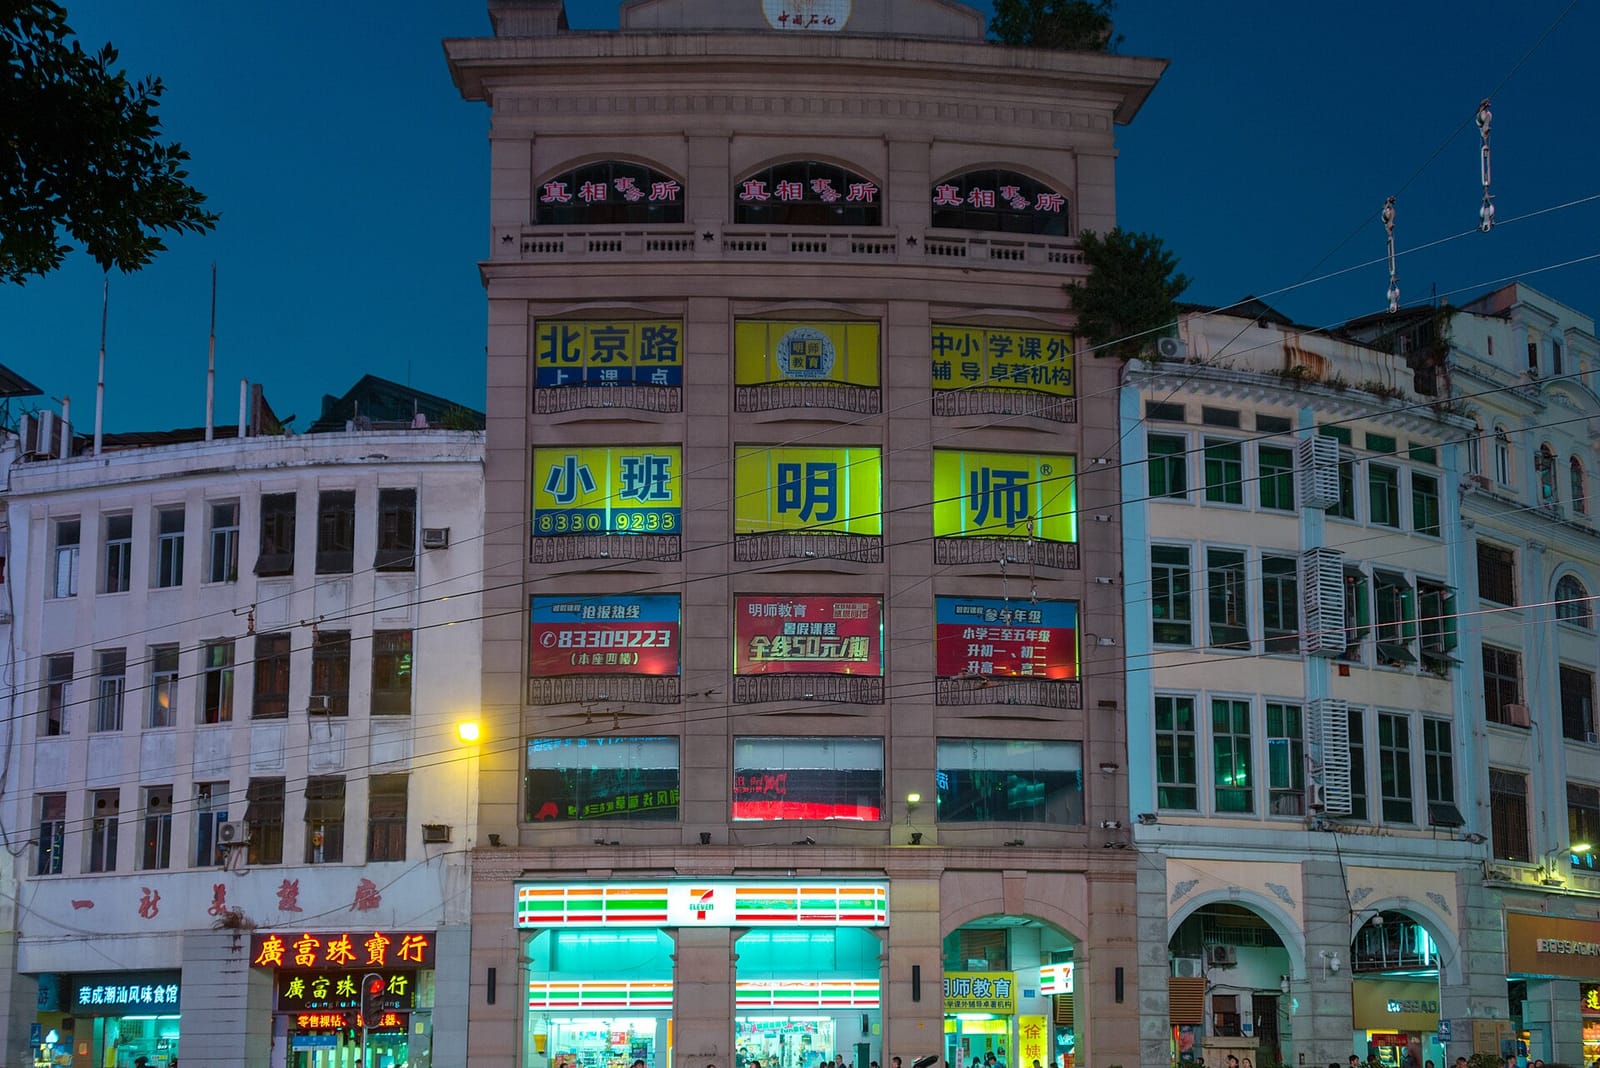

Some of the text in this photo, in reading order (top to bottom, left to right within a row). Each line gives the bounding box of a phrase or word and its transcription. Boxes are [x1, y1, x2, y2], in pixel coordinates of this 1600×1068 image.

[540, 176, 681, 203] 真相事务所
[739, 178, 878, 203] 真相事务所
[933, 184, 1066, 213] 真相事务所
[540, 325, 679, 363] 北京路
[932, 332, 1071, 363] 中小学课外
[932, 360, 1072, 387] 辅导卓著机构
[544, 454, 673, 505] 小班
[778, 462, 837, 522] 明
[970, 467, 1029, 528] 师
[539, 512, 676, 532] 8330 9233
[748, 603, 807, 618] 明师教育
[557, 630, 671, 648] 83309223
[783, 621, 838, 637] 暑假课程
[962, 628, 1051, 643] 小学三至五年级
[966, 643, 1048, 660] 升初一、初二
[254, 931, 428, 967] 廣富珠寶行
[79, 984, 179, 1005] 荣成潮汕风味食馆
[284, 974, 409, 1000] 廣富珠行
[944, 1000, 1012, 1009] 学课外辅导卓著机构
[1024, 1024, 1041, 1068] 徐姨
